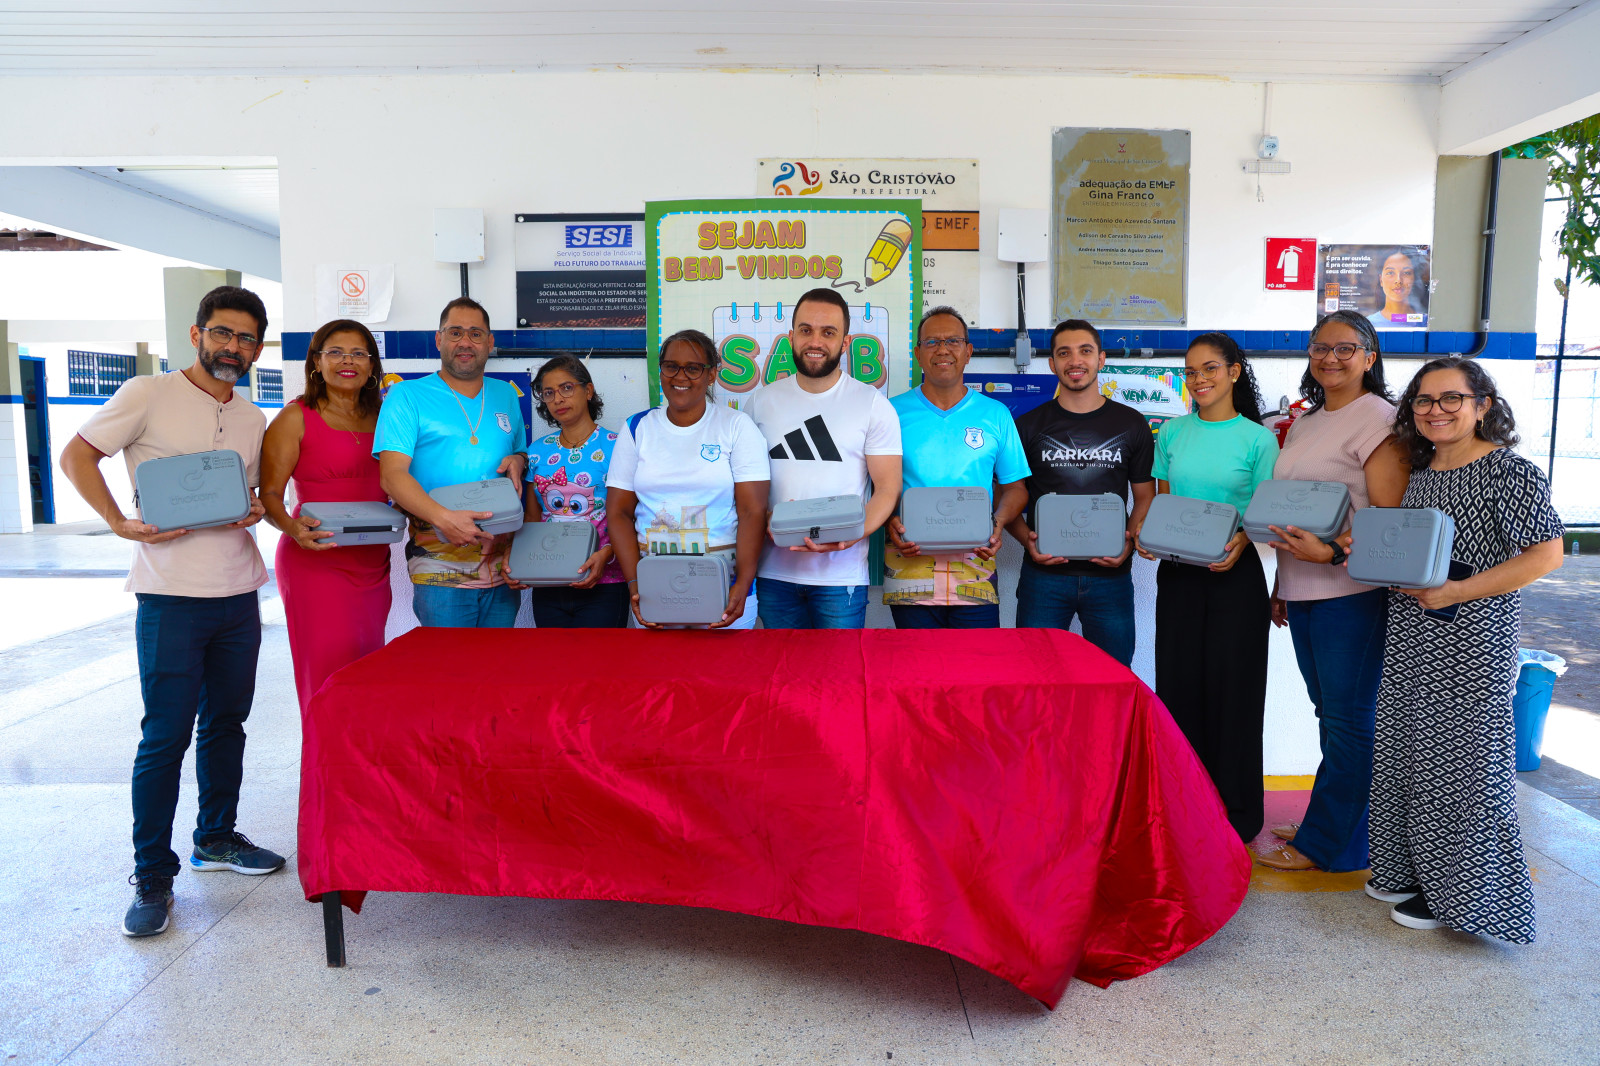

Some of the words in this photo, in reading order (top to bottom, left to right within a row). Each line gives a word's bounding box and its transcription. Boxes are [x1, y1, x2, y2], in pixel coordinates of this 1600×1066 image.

[1134, 180, 1147, 189] da
[1149, 180, 1176, 189] EMEF
[1089, 190, 1114, 200] Gina
[1117, 190, 1155, 200] Franco
[936, 217, 970, 229] EMEF
[571, 227, 627, 246] SESI
[698, 219, 807, 249] SEJAM
[556, 250, 581, 258] Serviço
[664, 255, 842, 281] BEM-VINDOS
[717, 334, 887, 392] SAB
[1121, 388, 1150, 404] VEM
[1041, 448, 1122, 464] KARKARÁ
